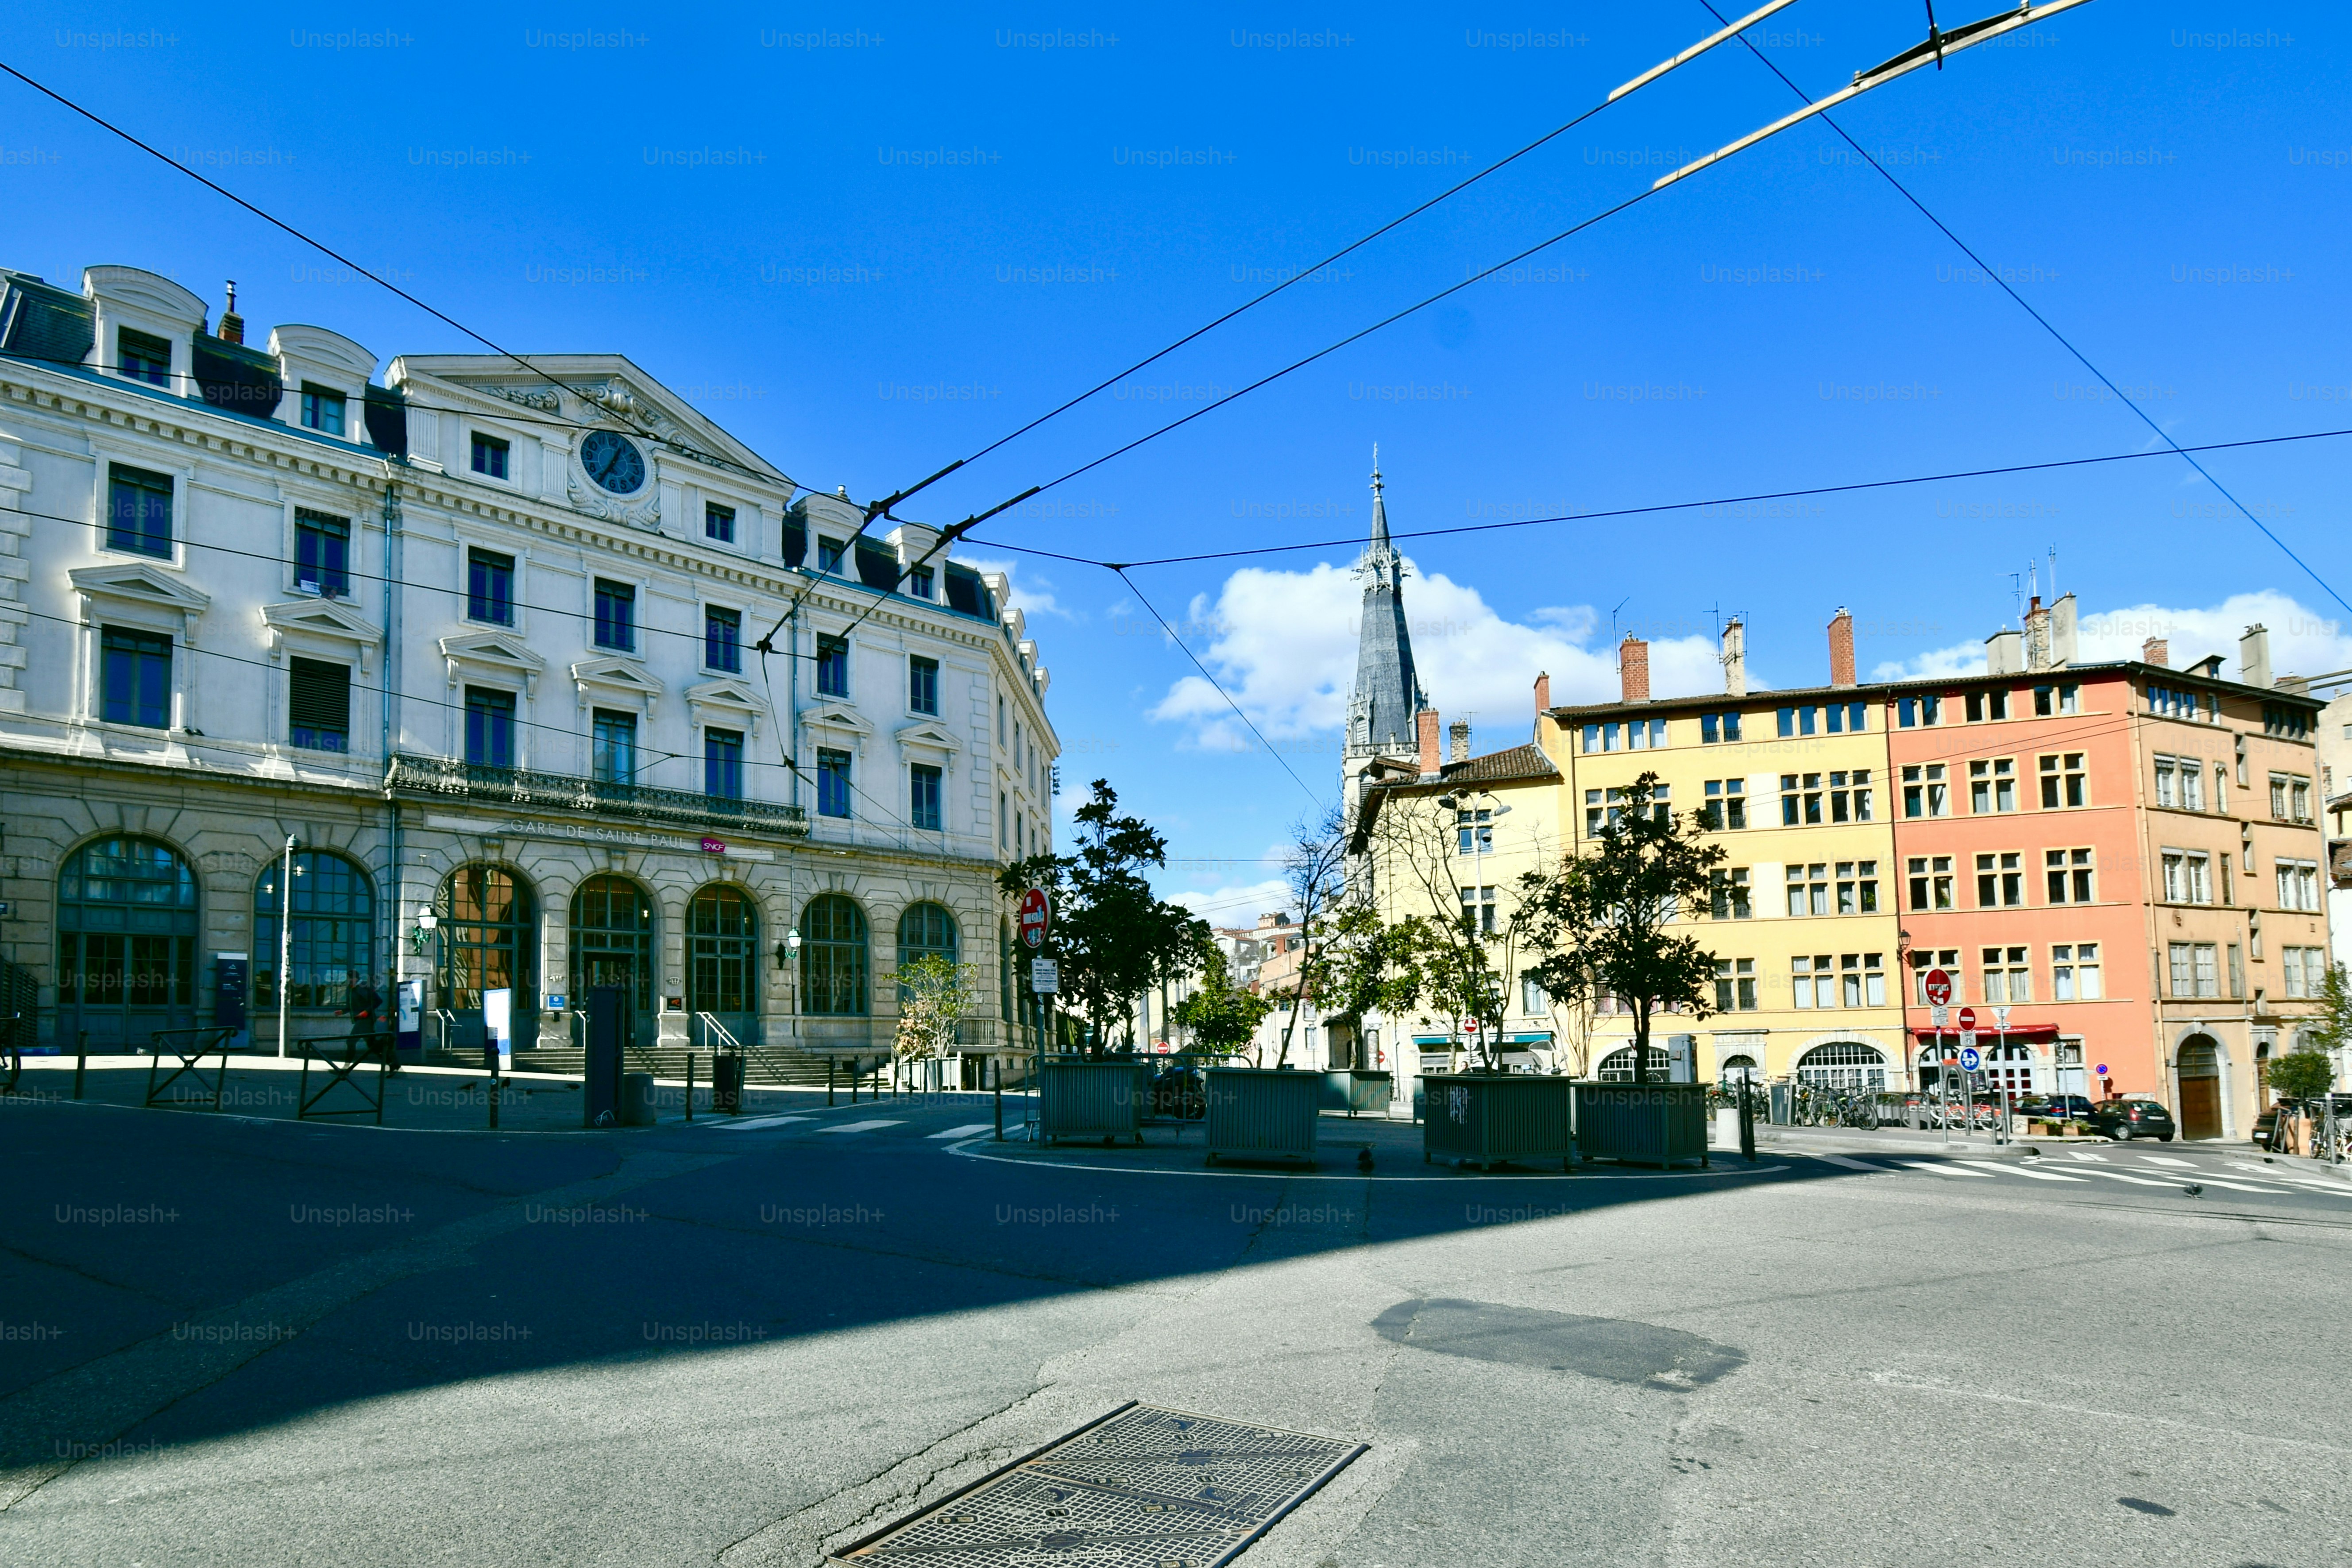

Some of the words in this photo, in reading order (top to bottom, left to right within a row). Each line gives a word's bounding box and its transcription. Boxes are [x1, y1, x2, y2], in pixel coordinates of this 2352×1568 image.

[599, 436, 605, 444] 11
[609, 437, 618, 447] 12
[588, 441, 597, 451] 10
[586, 451, 593, 460] 9
[630, 454, 637, 463] 2
[589, 463, 596, 472] 8
[633, 465, 639, 475] 3
[609, 479, 615, 488] 6
[620, 480, 626, 489] 5
[629, 476, 635, 485] 4
[511, 820, 555, 835] GARE
[567, 825, 585, 838] DE
[596, 828, 641, 844] SAINT
[651, 834, 684, 848] PAUL
